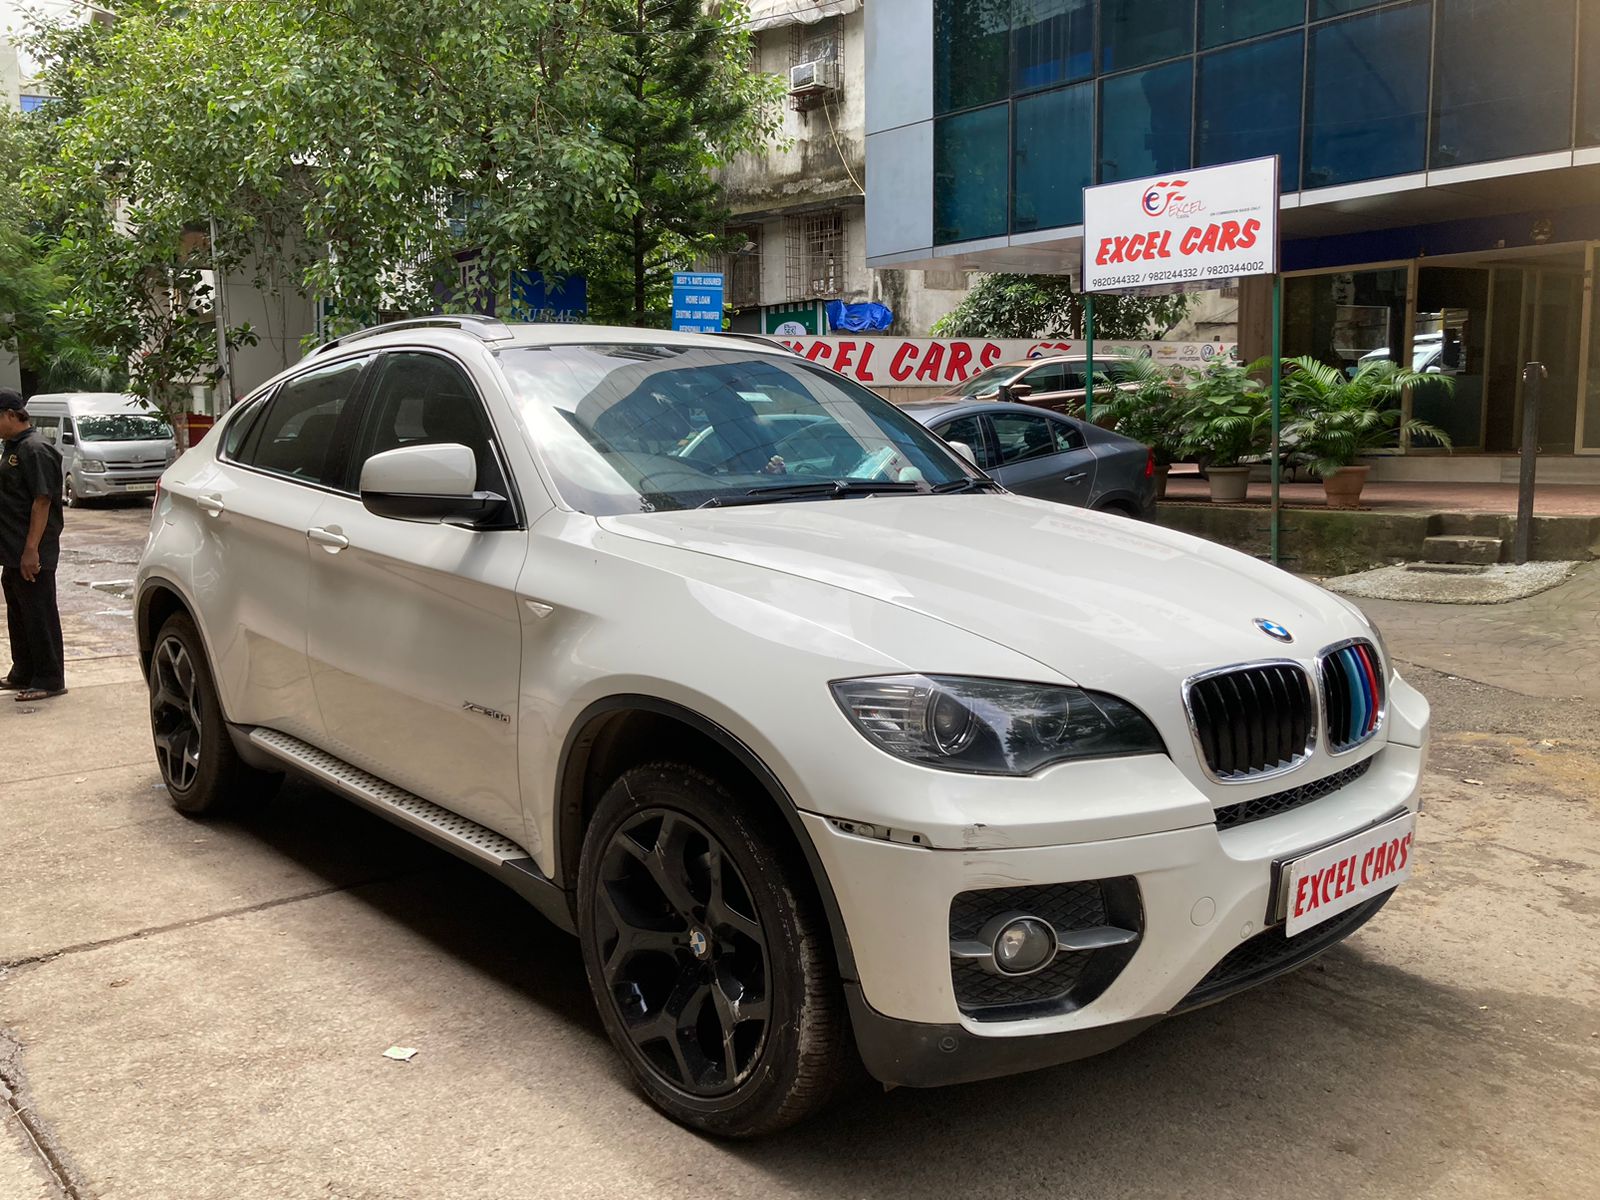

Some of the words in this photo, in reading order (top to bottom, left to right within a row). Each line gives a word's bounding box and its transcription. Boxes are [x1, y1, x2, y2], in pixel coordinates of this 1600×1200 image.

[1168, 200, 1207, 217] EXCEL
[1095, 230, 1172, 266] EXCEL
[1179, 218, 1261, 256] CARS
[1092, 274, 1140, 288] 9820344332
[1148, 267, 1198, 281] 9821244332
[1206, 261, 1264, 276] 9820344002
[685, 295, 698, 304] HOME
[698, 295, 711, 305] LOAN
[889, 341, 1002, 382] CARS
[1293, 854, 1357, 918] EXCEL
[1360, 832, 1412, 886] CARS
